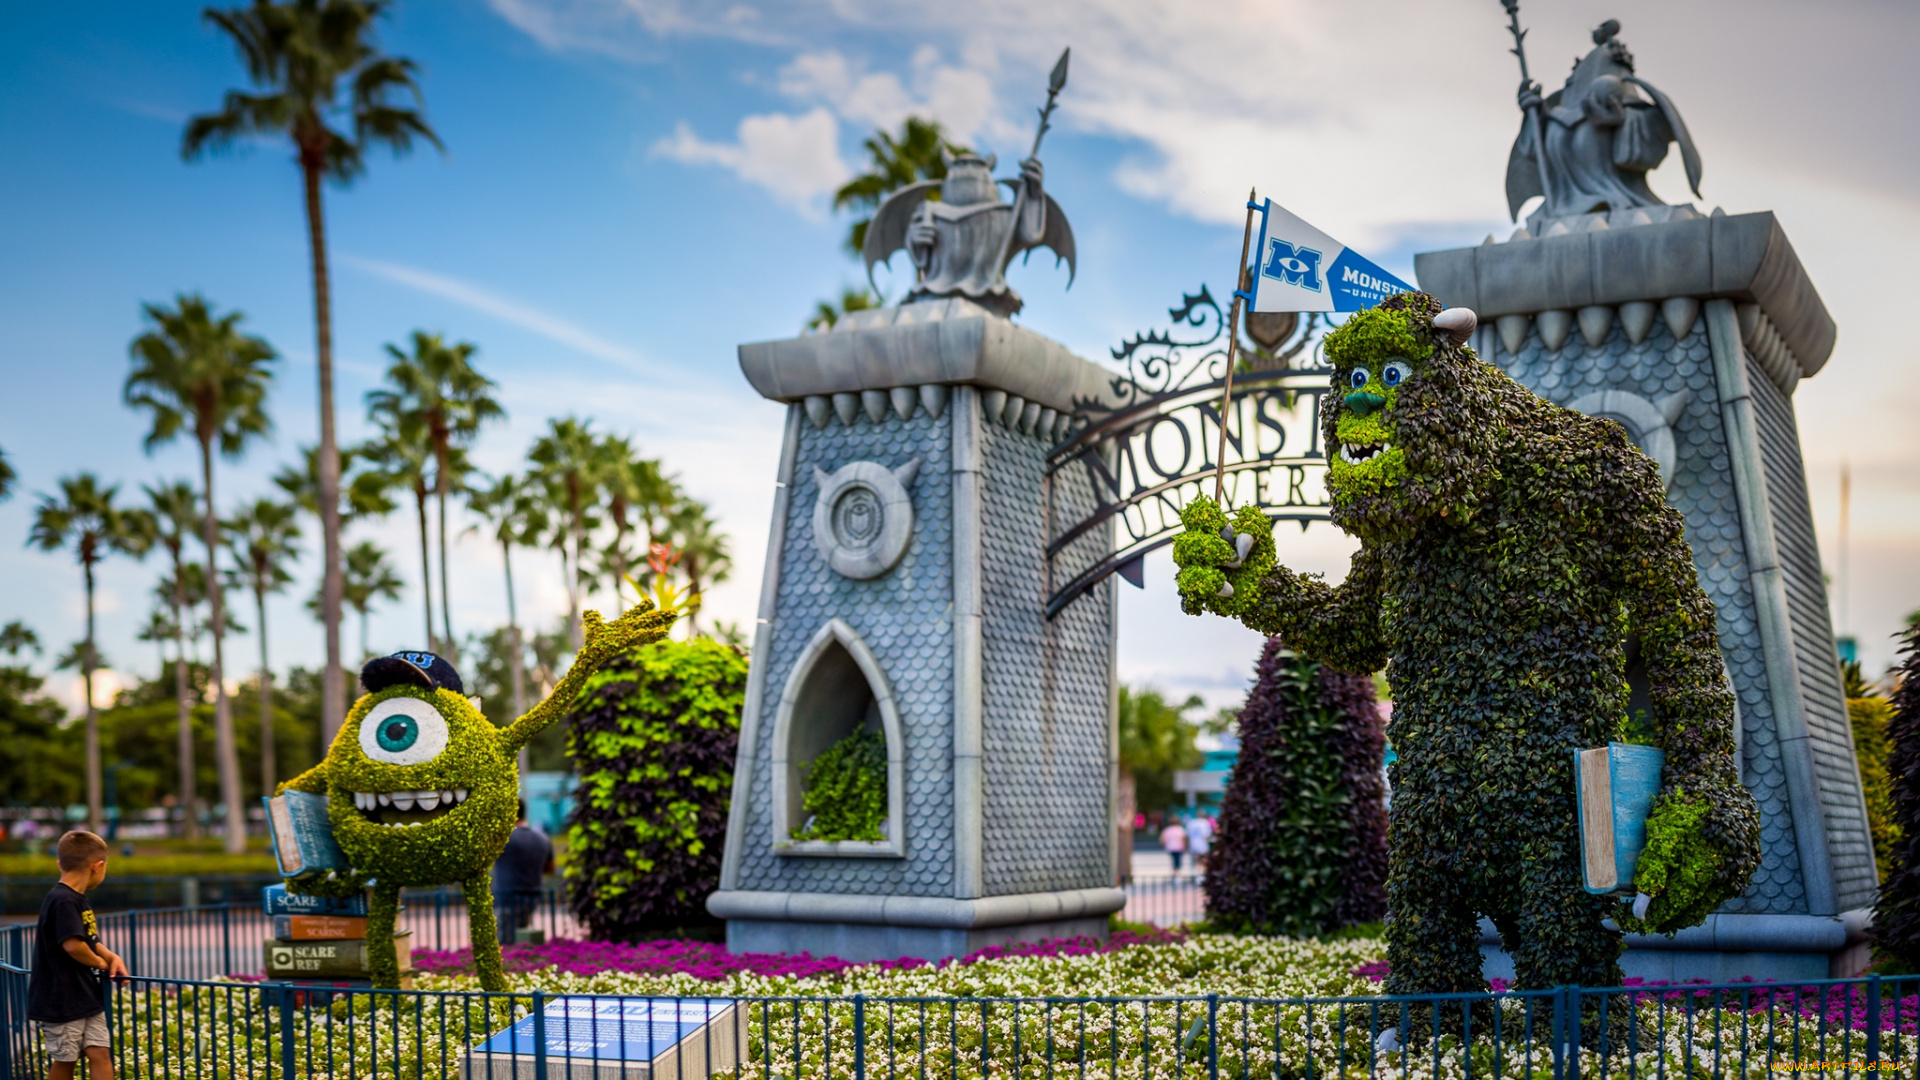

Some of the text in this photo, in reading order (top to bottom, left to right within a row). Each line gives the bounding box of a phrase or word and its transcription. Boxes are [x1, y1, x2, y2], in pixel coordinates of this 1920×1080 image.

[277, 895, 318, 907] SCARE
[306, 928, 346, 938] SCARING
[294, 946, 336, 958] SCARE
[296, 960, 322, 971] REF
